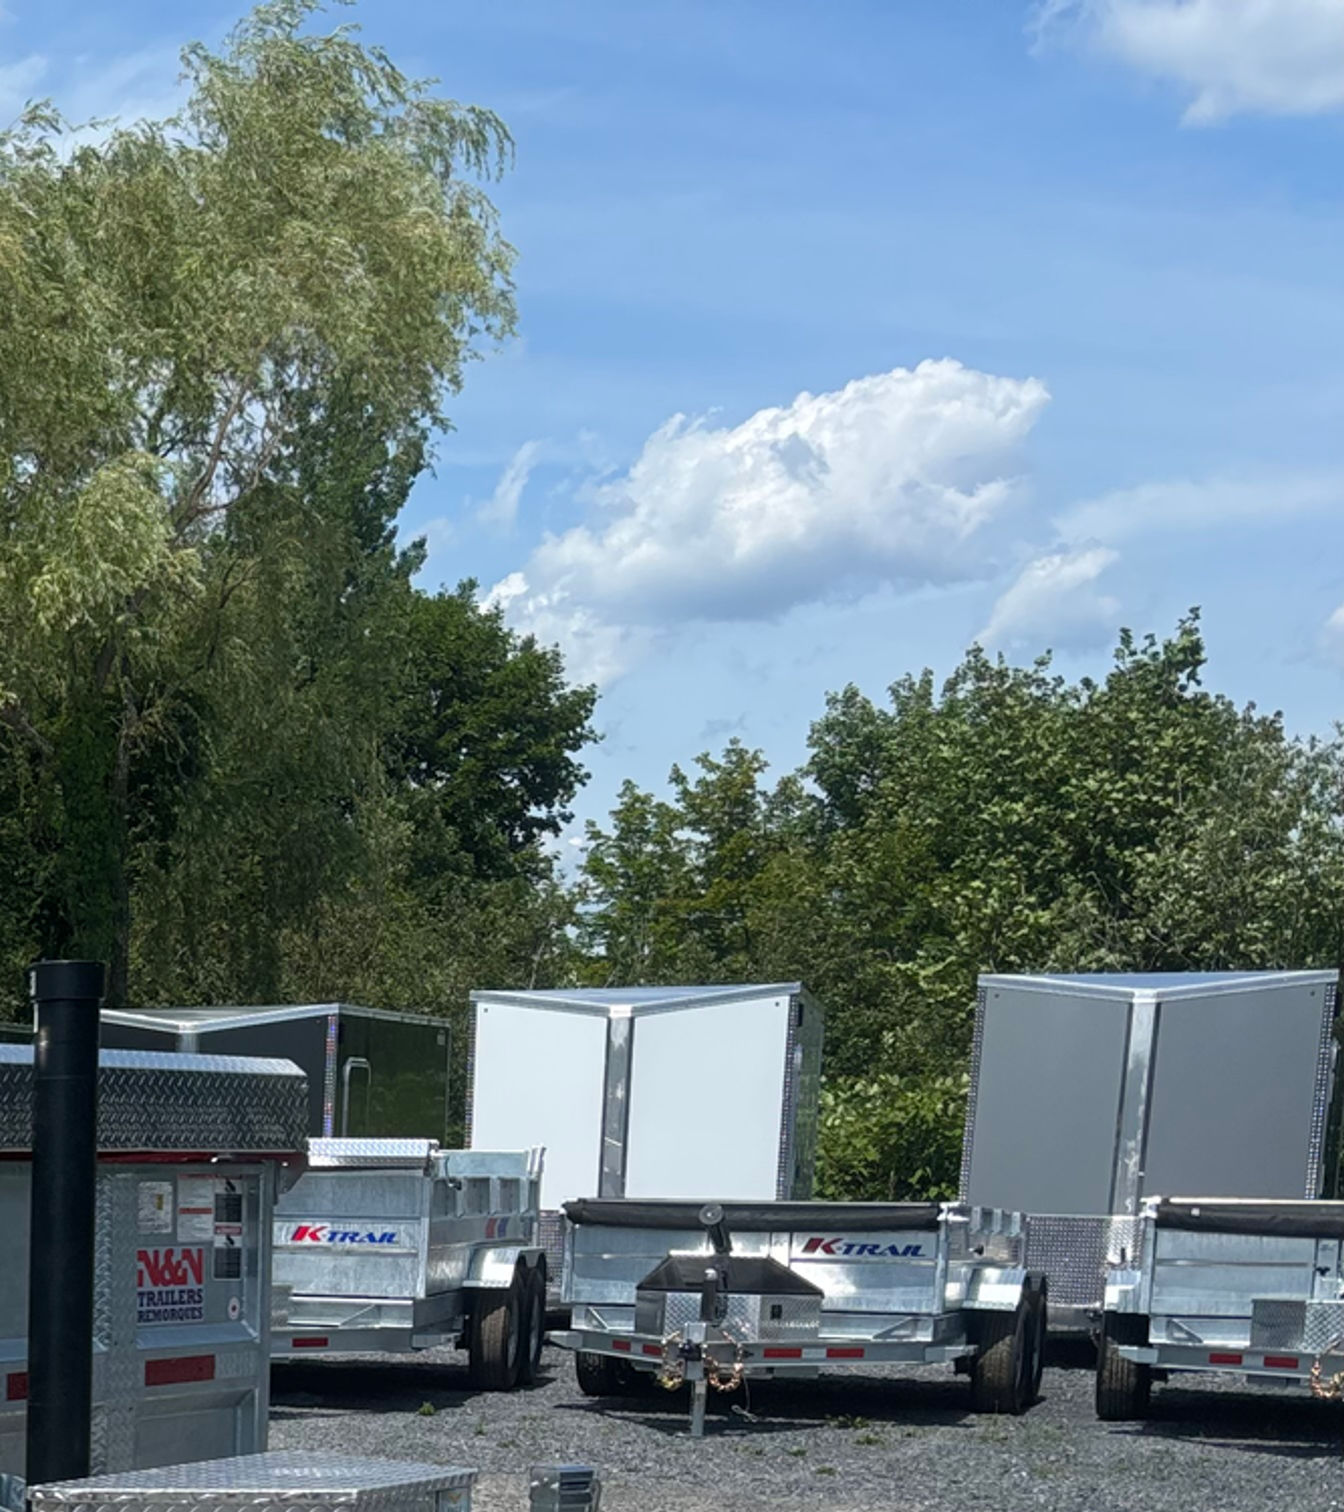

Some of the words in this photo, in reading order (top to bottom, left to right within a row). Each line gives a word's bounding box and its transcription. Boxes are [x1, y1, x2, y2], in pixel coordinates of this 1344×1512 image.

[137, 1248, 204, 1288] N&N
[137, 1288, 204, 1308] TRAILERS
[137, 1307, 204, 1324] REMORQUES
